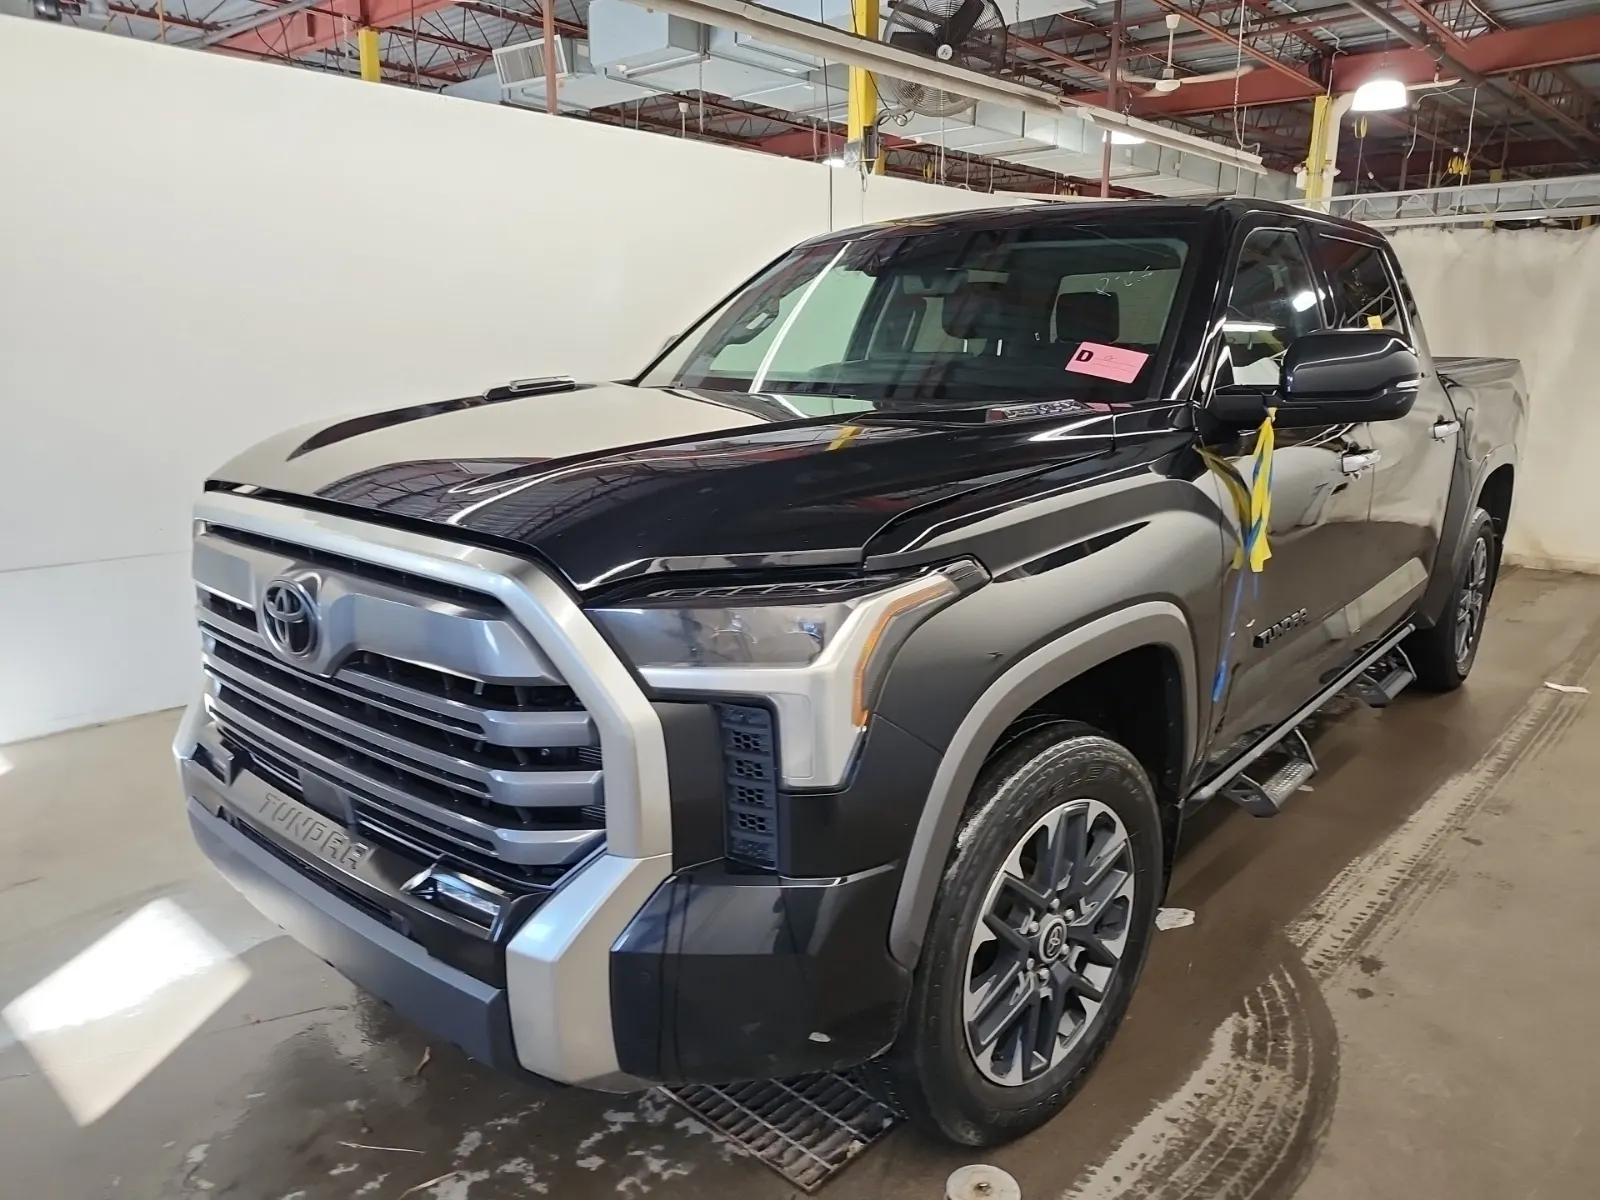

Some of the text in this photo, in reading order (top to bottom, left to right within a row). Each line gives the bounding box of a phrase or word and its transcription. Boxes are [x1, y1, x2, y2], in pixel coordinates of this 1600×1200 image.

[1076, 350, 1094, 362] D
[1253, 608, 1308, 648] TUNDRA
[258, 792, 369, 870] TUNDRA
